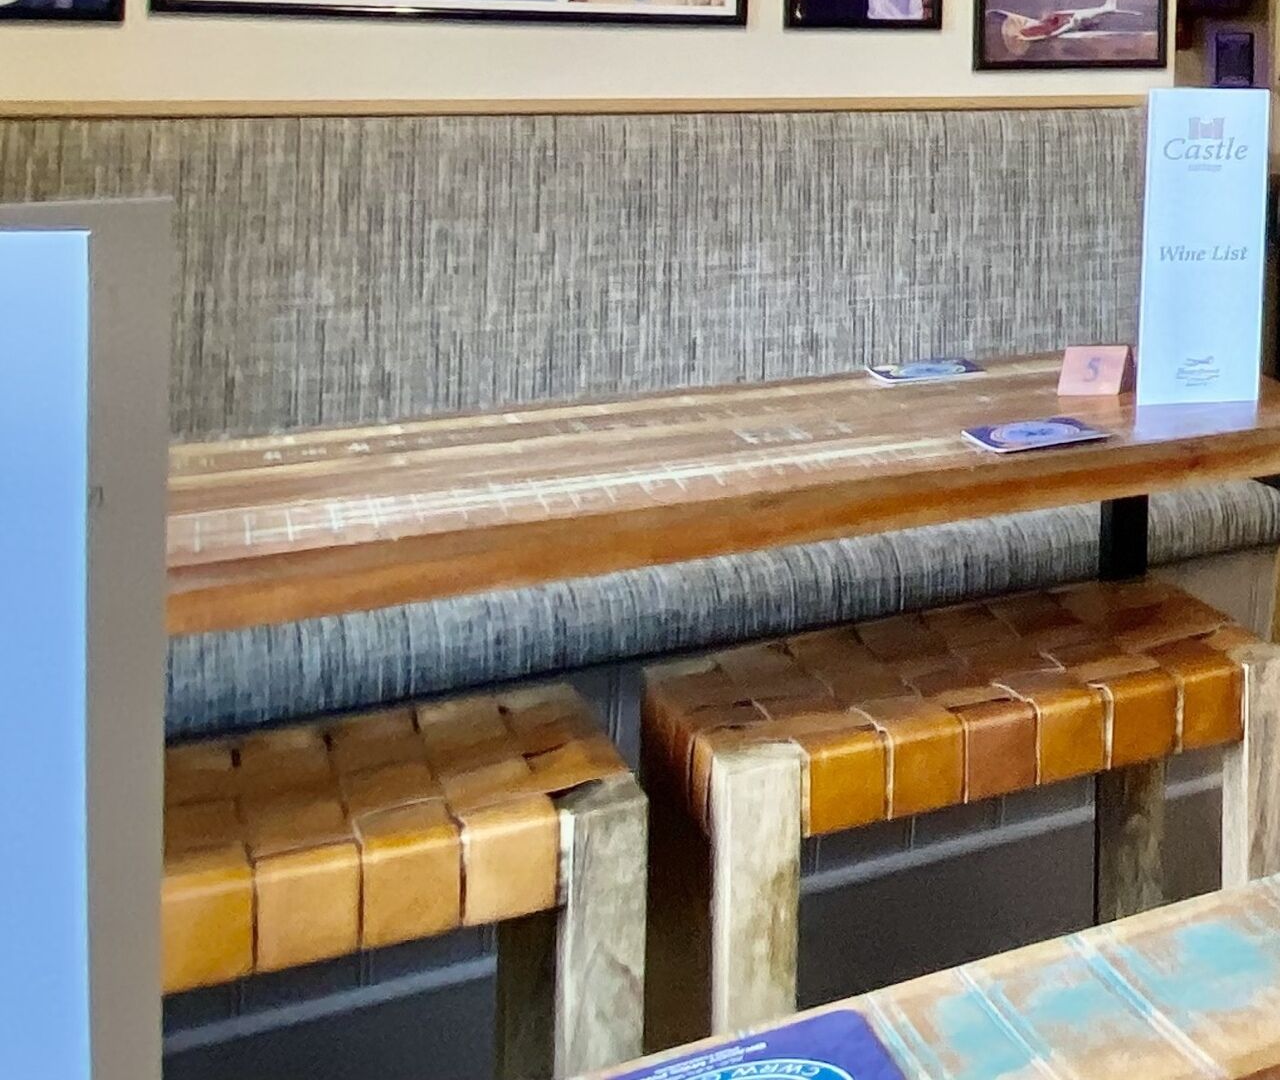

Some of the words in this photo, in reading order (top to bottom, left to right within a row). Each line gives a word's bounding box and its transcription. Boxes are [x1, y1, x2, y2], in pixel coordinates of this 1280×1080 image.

[1163, 137, 1249, 161] Castle
[1159, 245, 1206, 262] Wine
[1212, 245, 1249, 262] List
[1084, 357, 1102, 383] 5
[731, 1063, 820, 1079] CWRW
